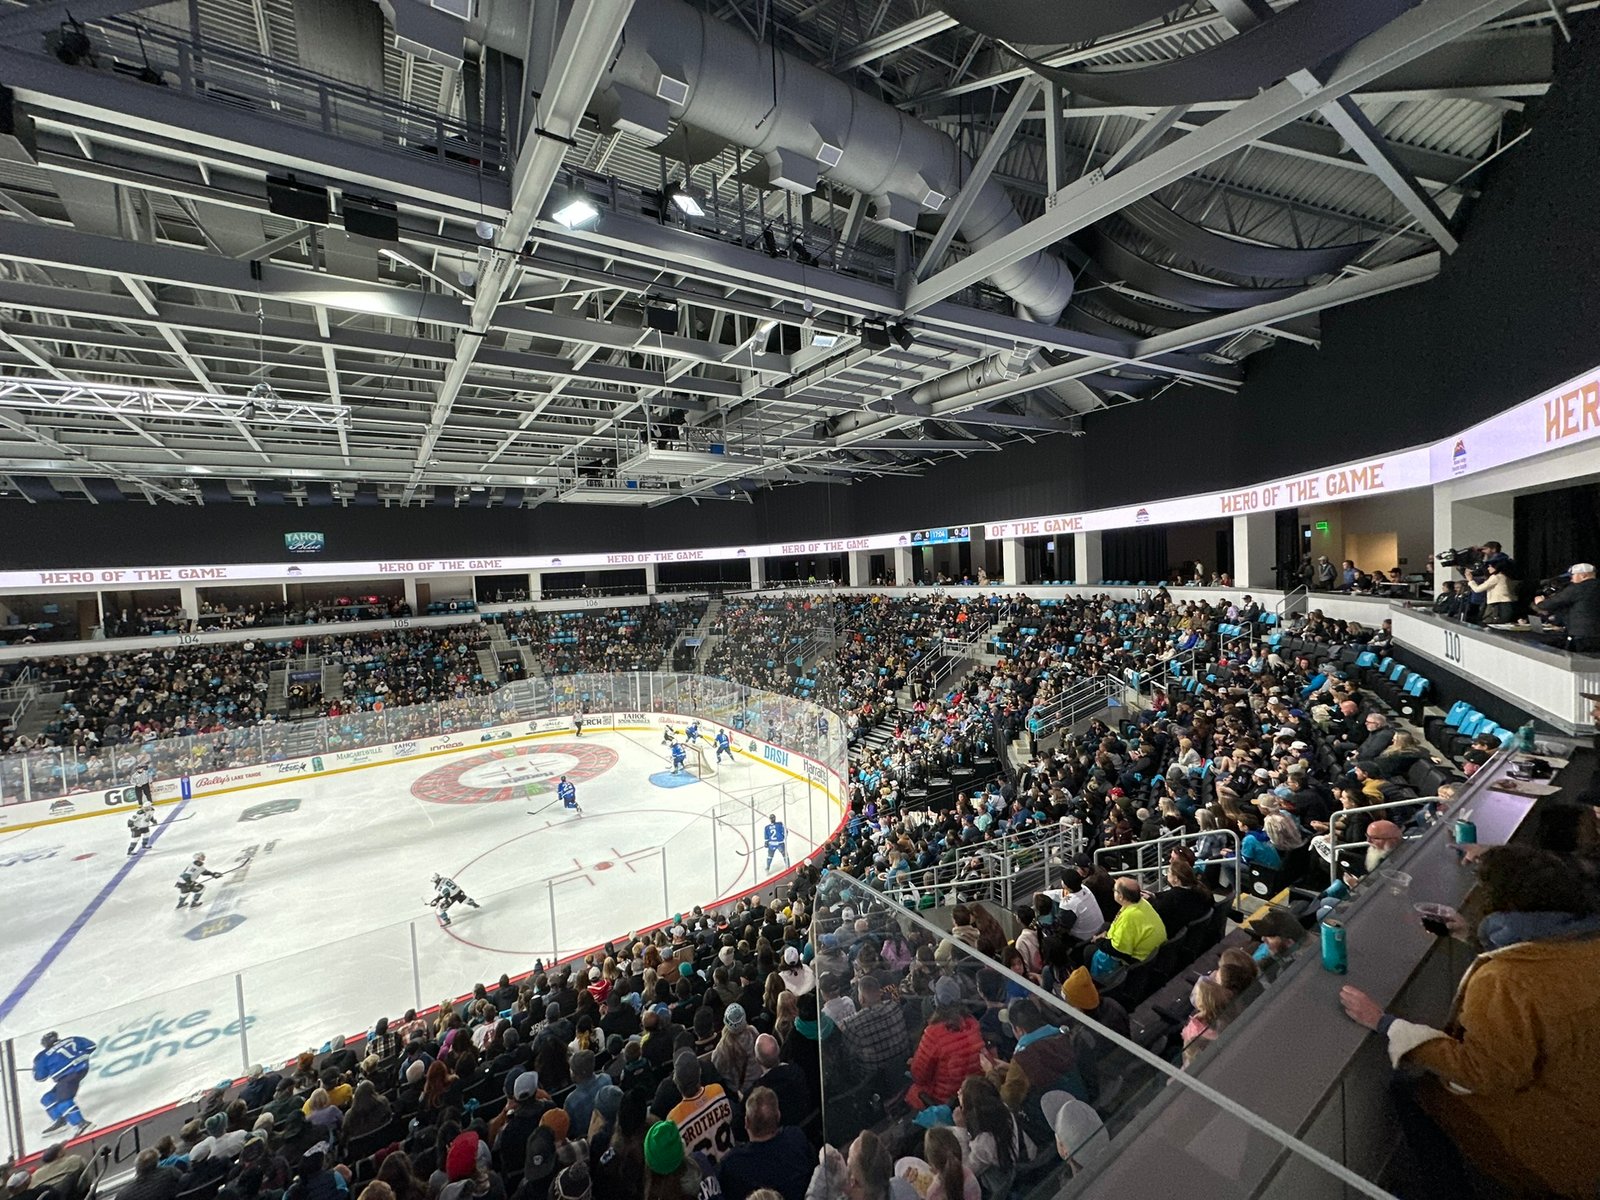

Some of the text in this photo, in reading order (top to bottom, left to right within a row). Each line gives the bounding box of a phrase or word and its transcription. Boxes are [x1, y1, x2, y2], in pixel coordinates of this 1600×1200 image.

[1220, 463, 1384, 513] HERO OF THE GAME
[992, 517, 1082, 537] OF THE GAME
[285, 532, 324, 541] TAHOE
[782, 539, 869, 554] HERO OF THE GAME
[607, 555, 634, 563] HERO
[676, 551, 703, 559] GAME
[378, 560, 502, 572] HERO OF THE GAME
[40, 568, 227, 584] HERO OF THE GAME
[394, 620, 409, 628] 105
[178, 635, 199, 644] 104
[1444, 630, 1461, 663] 110
[764, 745, 789, 766] DASH
[195, 775, 230, 788] Bally's
[770, 829, 777, 840] 2
